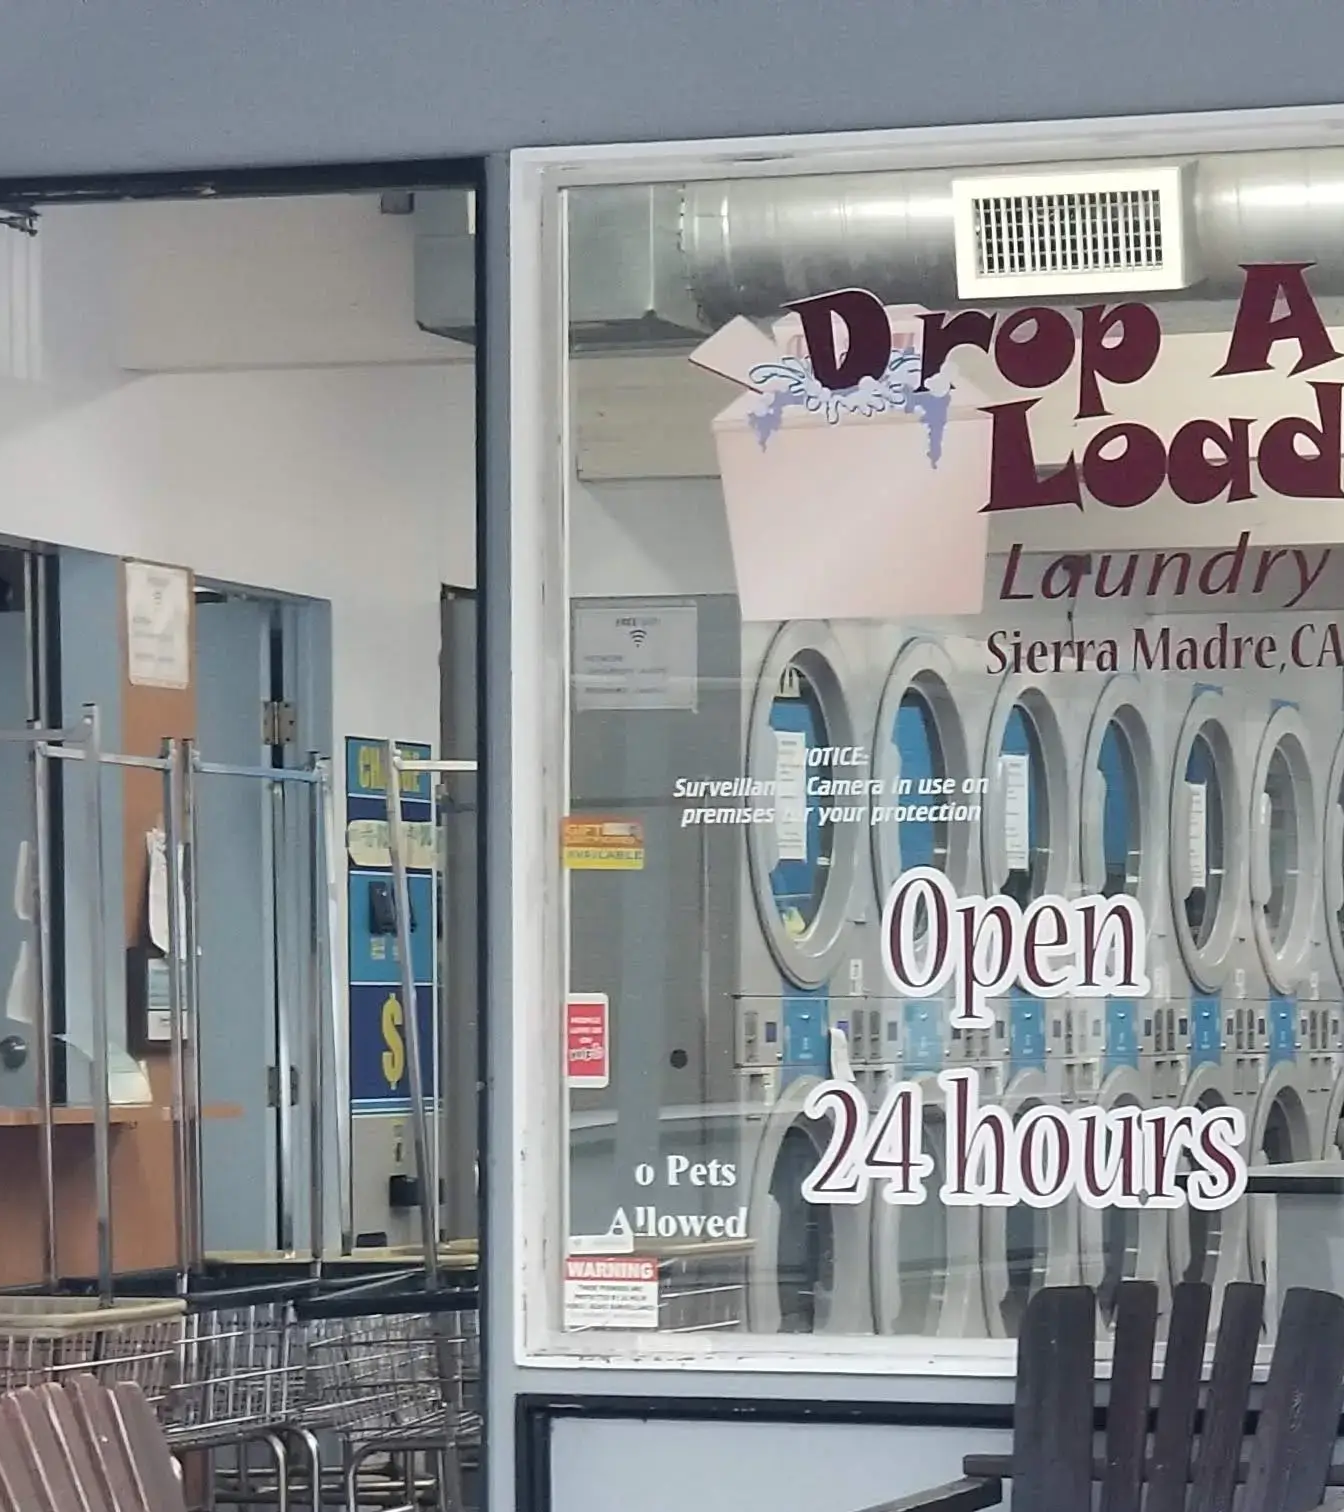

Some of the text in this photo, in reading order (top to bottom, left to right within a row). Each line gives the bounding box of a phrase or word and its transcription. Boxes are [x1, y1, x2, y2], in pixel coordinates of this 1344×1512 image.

[783, 288, 1161, 418] Drop
[1000, 532, 1331, 607] Laundry
[986, 630, 1118, 675] Sierra
[673, 776, 989, 798] Surveillan Camera in use on
[680, 806, 776, 828] premises
[818, 804, 865, 827] your
[869, 801, 982, 826] protection
[886, 872, 1144, 1022] Open
[807, 1072, 1243, 1203] 24 hours
[666, 1154, 737, 1187] Pets
[608, 1206, 748, 1238] Allowed
[567, 1261, 654, 1279] WARNING
